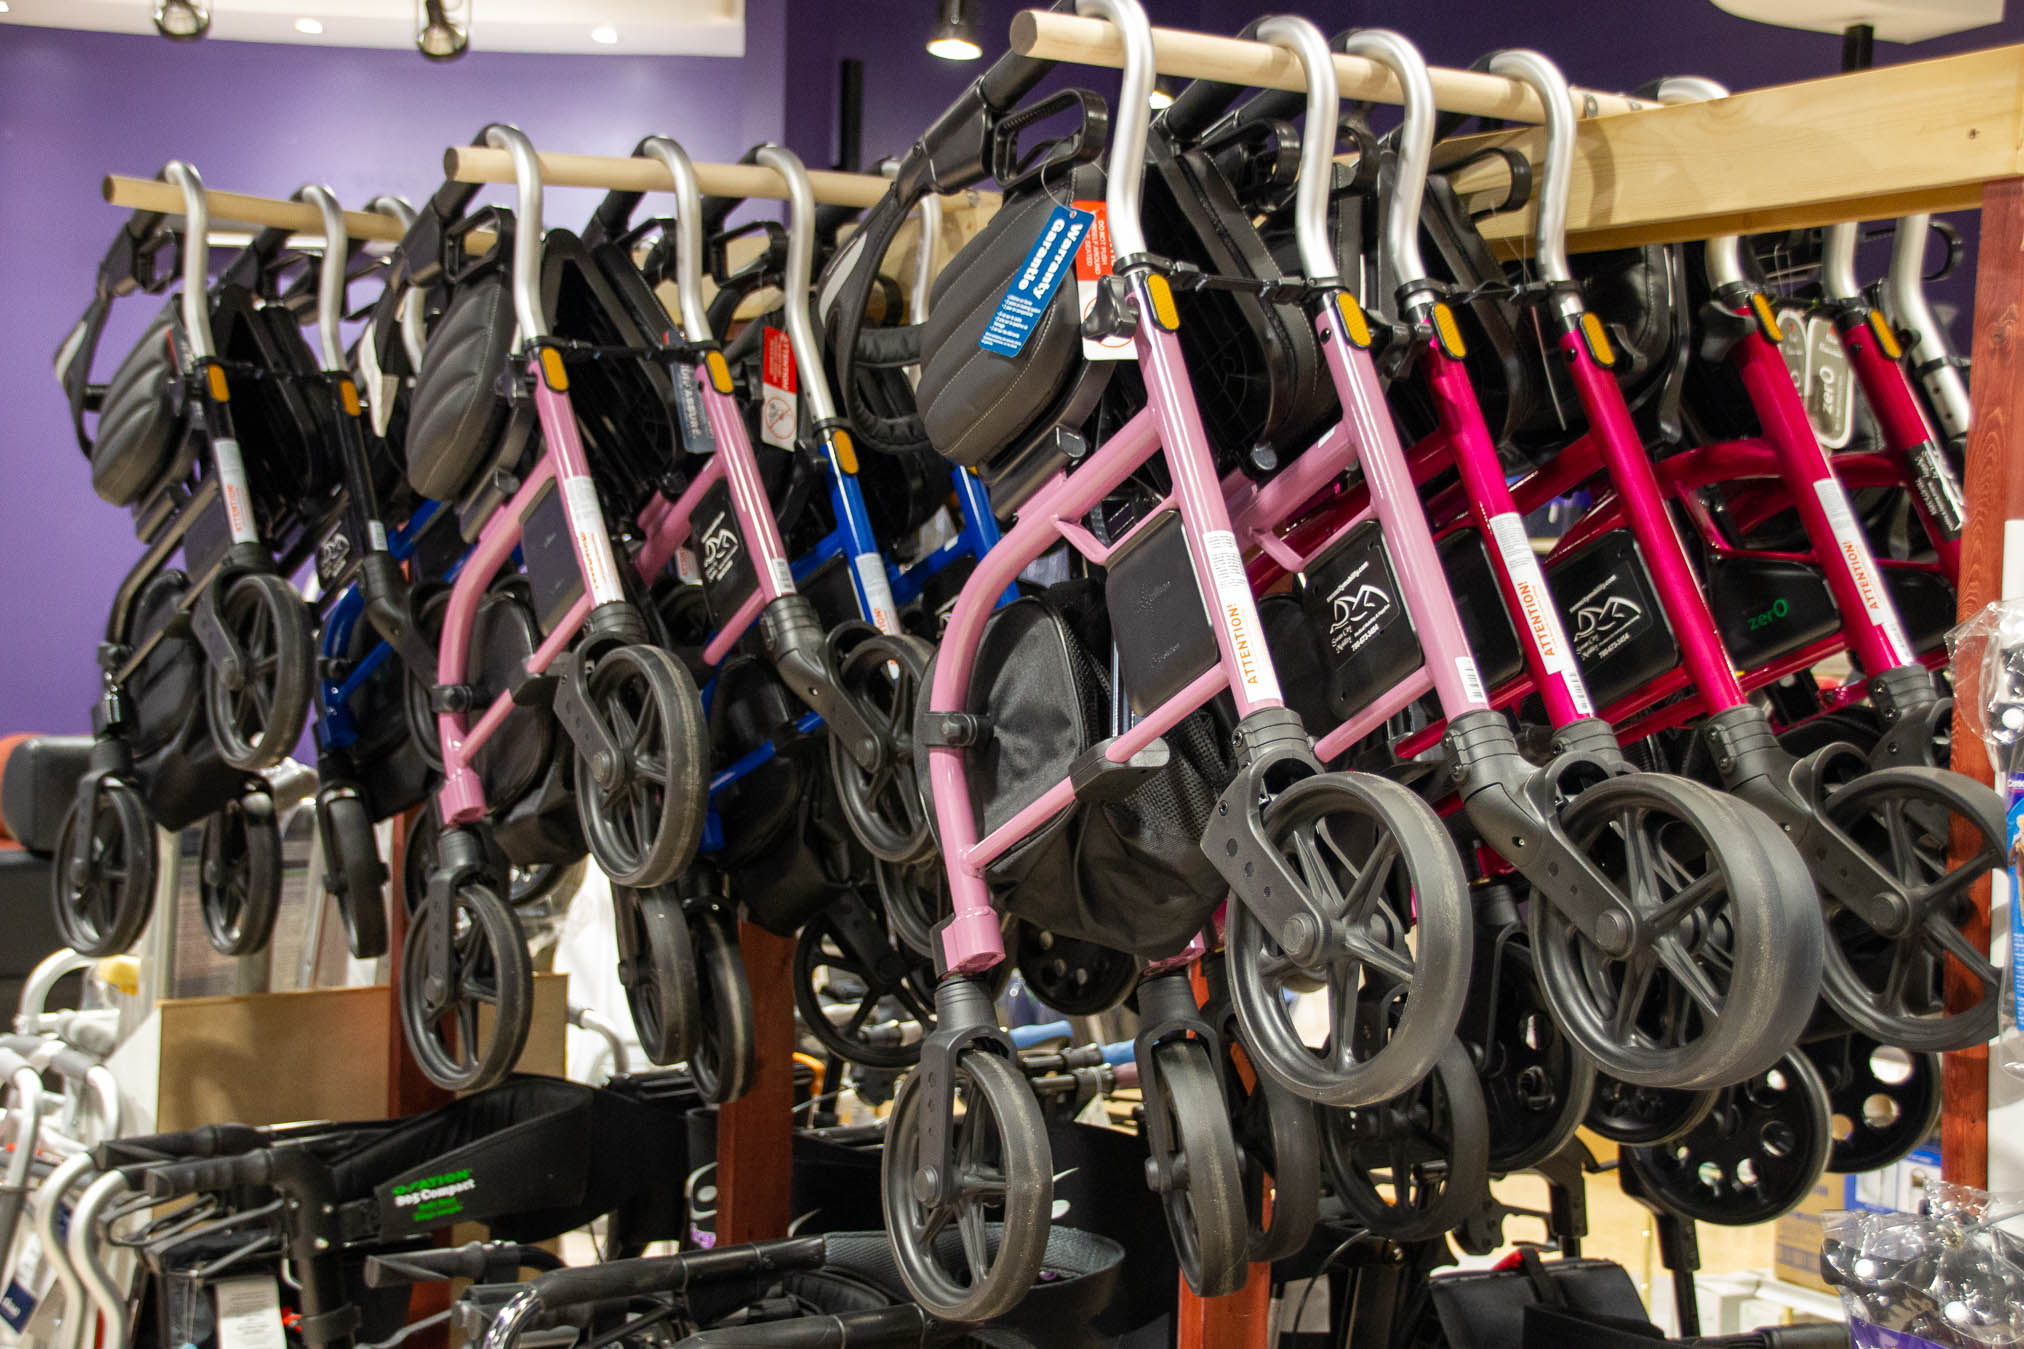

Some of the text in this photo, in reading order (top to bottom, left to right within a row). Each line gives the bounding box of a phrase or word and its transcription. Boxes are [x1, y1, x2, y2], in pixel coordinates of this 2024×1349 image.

[1018, 219, 1065, 290] Garantie
[1033, 224, 1083, 299] Warranty
[1842, 540, 1880, 609] ATTENTION!
[1226, 604, 1259, 684] ATTENTION!
[1517, 581, 1555, 656] ATTENTION!
[420, 1179, 475, 1200] Compact
